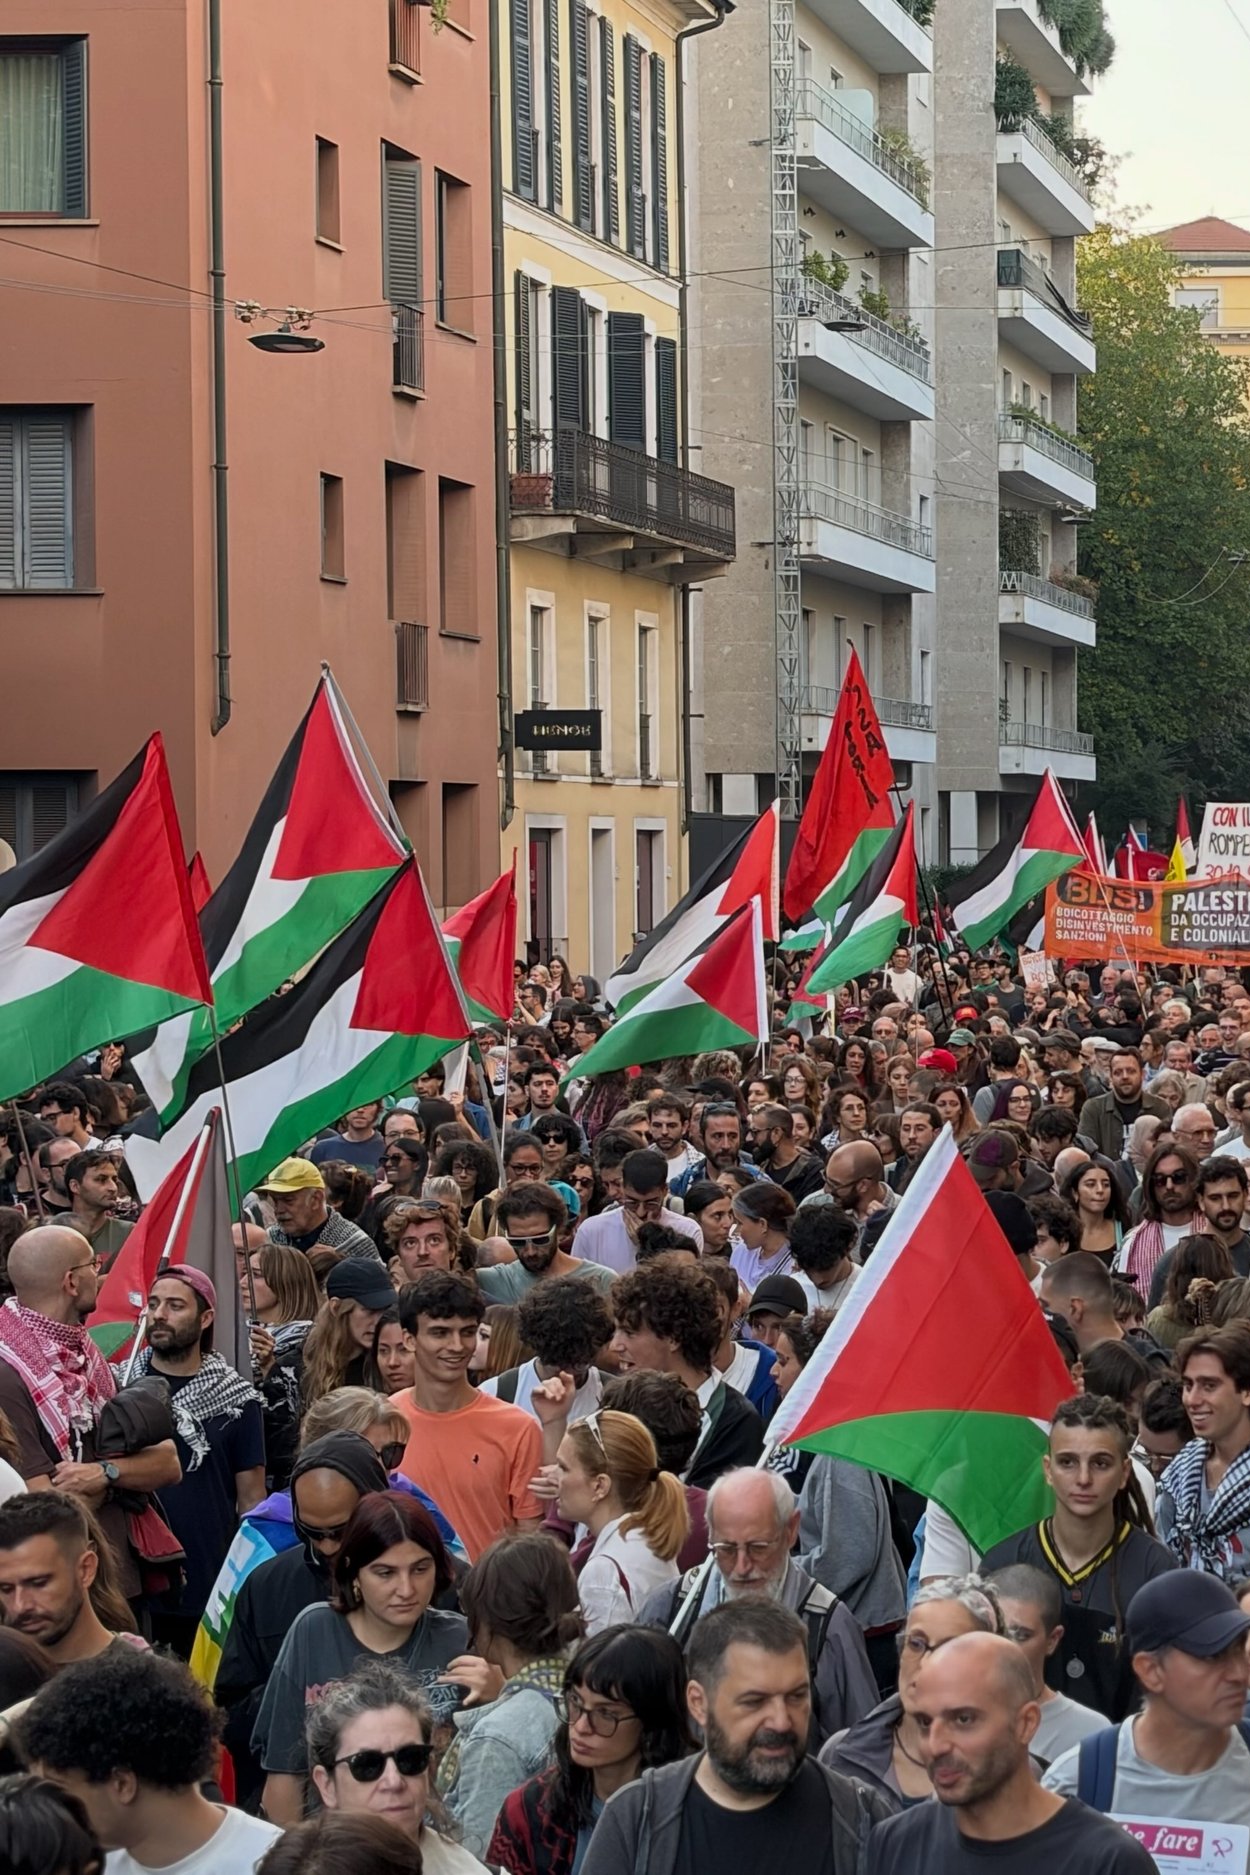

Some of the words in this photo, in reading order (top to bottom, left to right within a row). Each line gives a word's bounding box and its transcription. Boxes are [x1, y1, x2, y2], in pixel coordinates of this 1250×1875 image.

[1212, 806, 1238, 828] CON
[1056, 906, 1135, 924] BOICOTTAGGIO
[1170, 913, 1188, 927] DA
[1055, 918, 1154, 937] DISINVESTIMENTO
[1055, 929, 1107, 942] SANZIONI
[1170, 928, 1180, 941] E
[1148, 1826, 1199, 1852] fare
